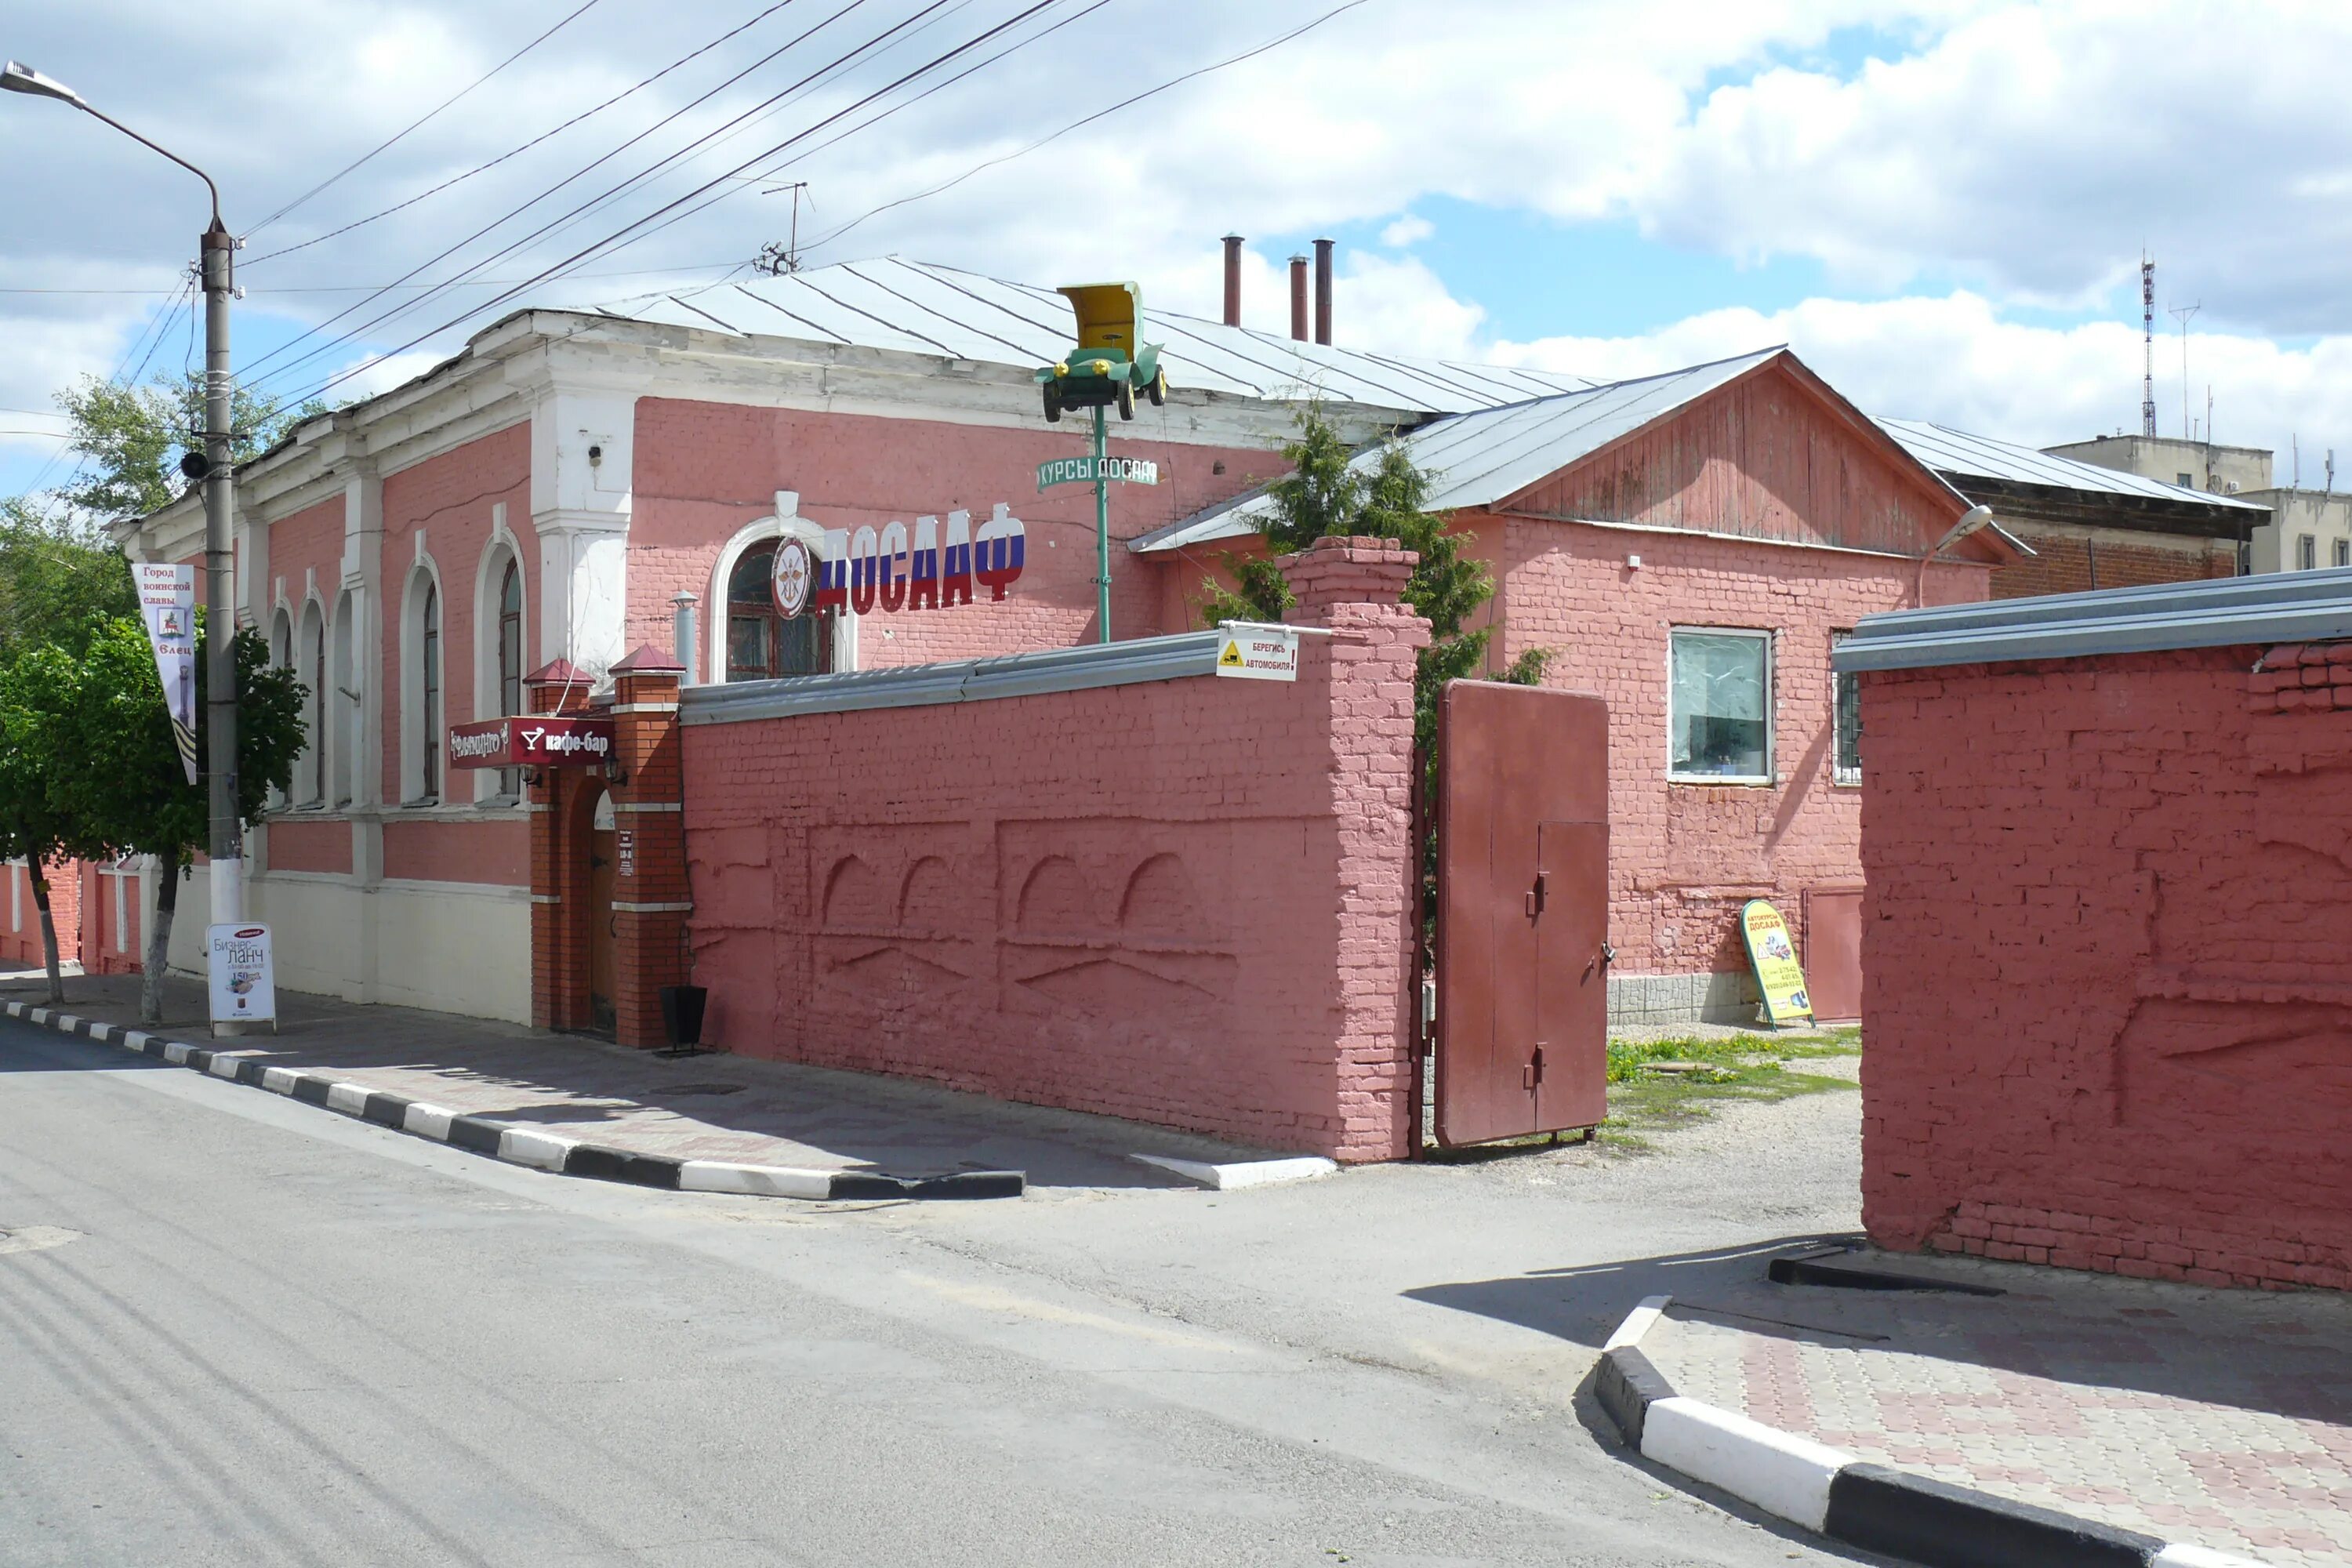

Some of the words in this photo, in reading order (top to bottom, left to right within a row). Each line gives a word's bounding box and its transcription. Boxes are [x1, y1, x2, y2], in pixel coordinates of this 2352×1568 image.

[1098, 459, 1157, 481] ДОСААФ
[816, 503, 1025, 619] ДОСААФ
[143, 567, 175, 578] Город
[143, 582, 191, 591] воинской
[159, 644, 192, 656] Елец
[1252, 642, 1286, 654] БЕРЕГИСЬ
[1245, 659, 1290, 671] АВТОМОБИЛЯ
[546, 730, 608, 757] кафе-бар
[1749, 920, 1781, 931] ДОСААФ
